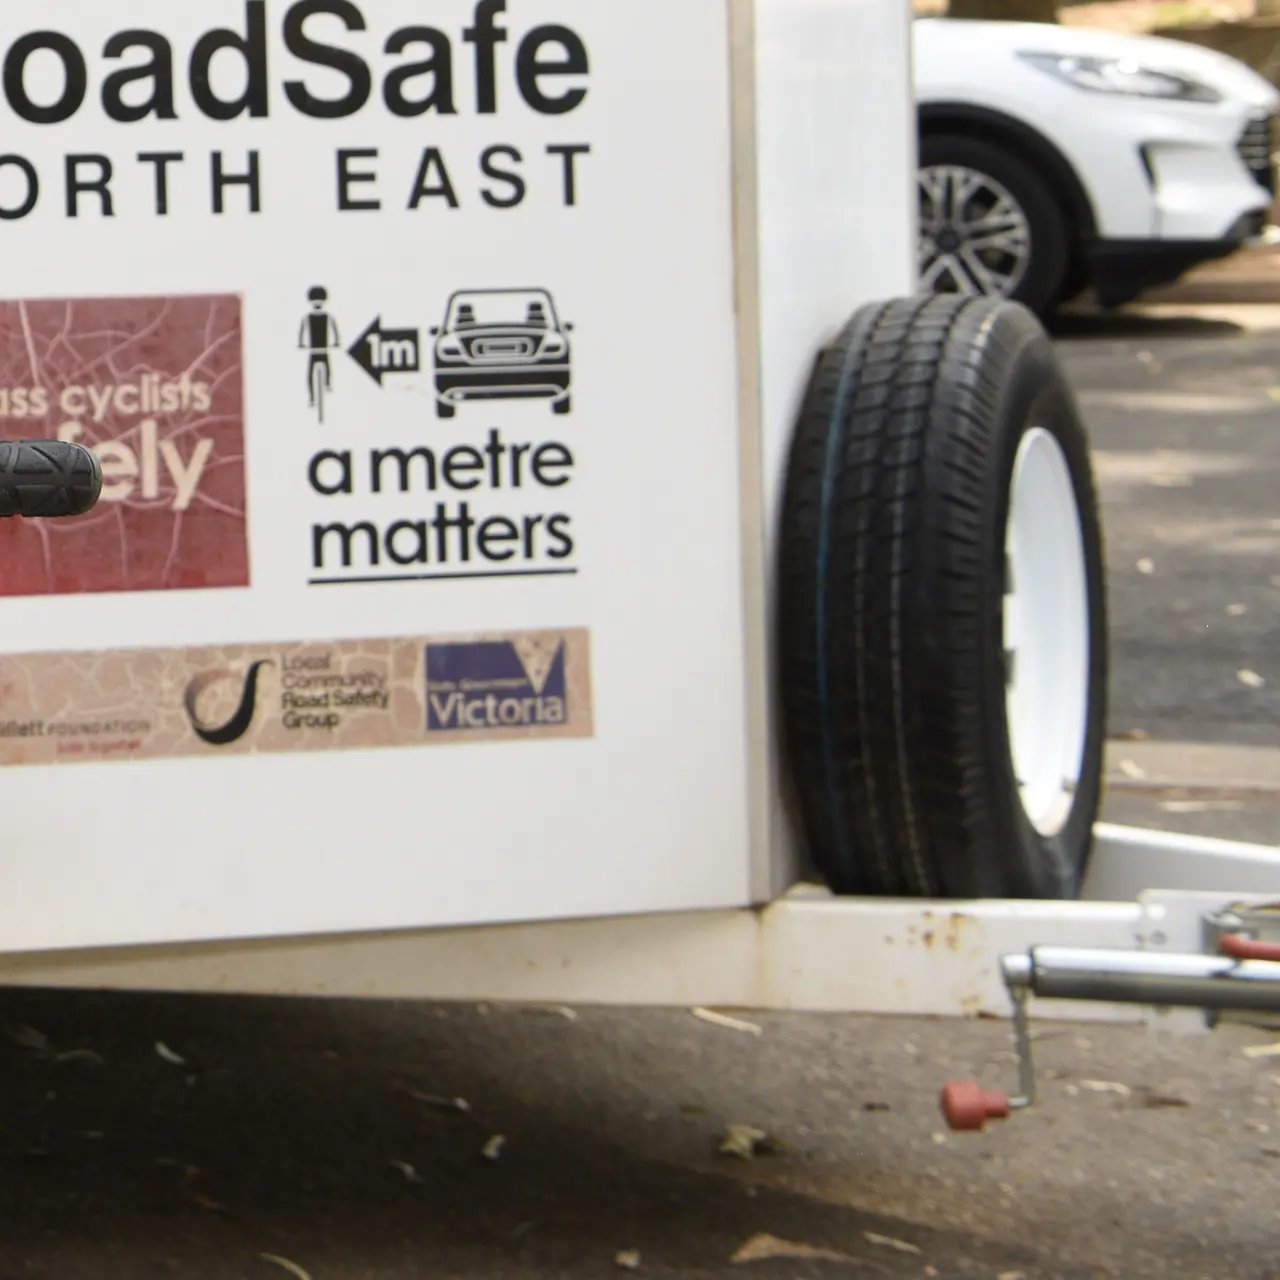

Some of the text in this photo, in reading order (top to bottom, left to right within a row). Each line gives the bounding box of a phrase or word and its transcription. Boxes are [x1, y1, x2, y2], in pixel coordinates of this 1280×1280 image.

[336, 143, 591, 211] EAST
[366, 332, 417, 369] 1m
[59, 373, 212, 422] cyclists
[307, 427, 574, 496] a metre
[312, 500, 574, 569] matters
[429, 691, 564, 727] Victoria
